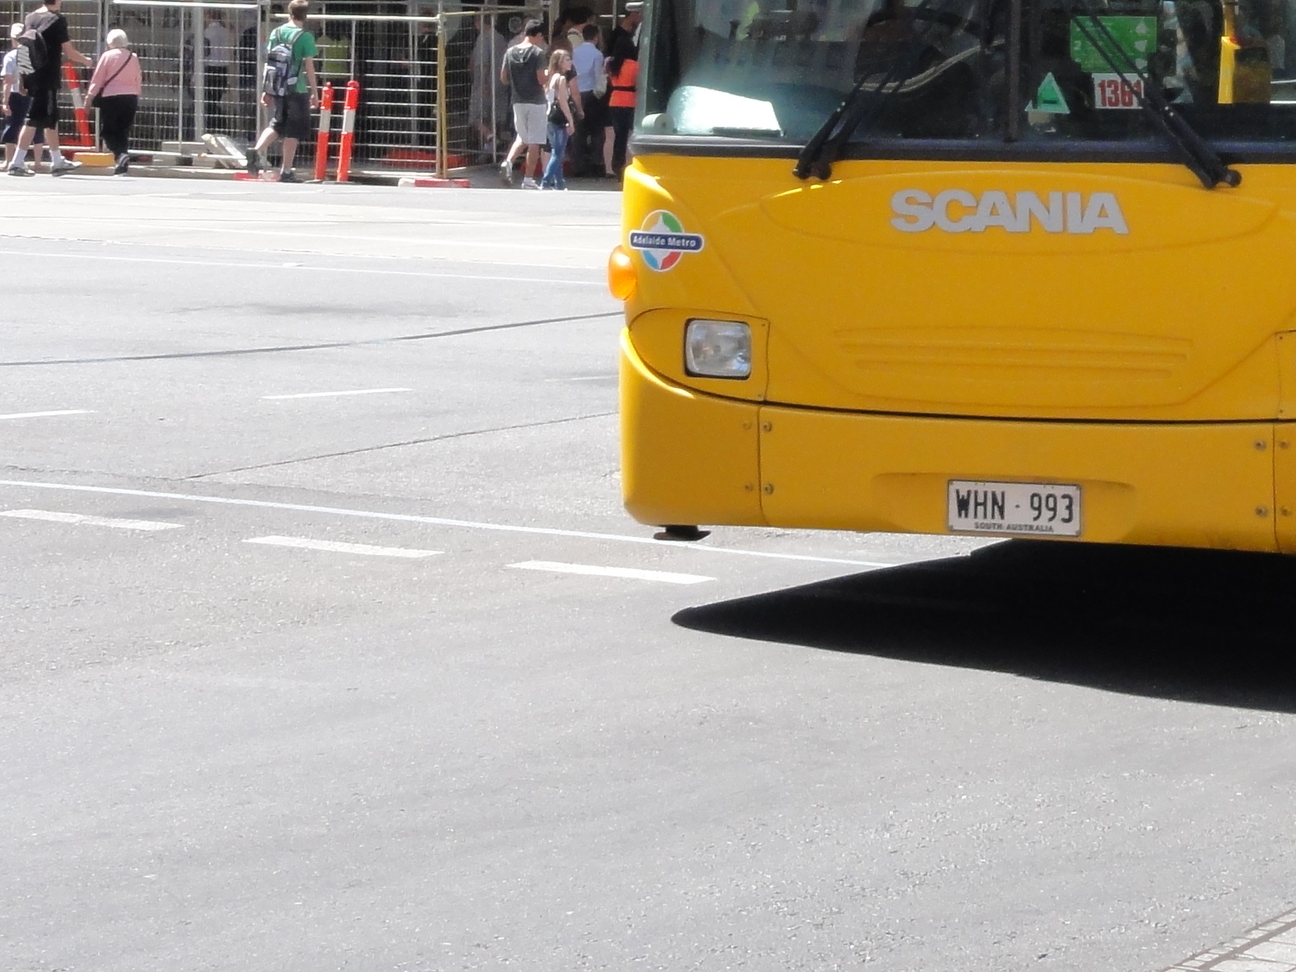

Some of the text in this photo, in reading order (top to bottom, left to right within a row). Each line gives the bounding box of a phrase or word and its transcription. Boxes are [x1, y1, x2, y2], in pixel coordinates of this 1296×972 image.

[890, 189, 1130, 234] SCANIA
[632, 235, 697, 247] Adelaide Metro
[956, 488, 1074, 524] WHN 993
[974, 522, 1054, 533] SOUTH AUSTRALIA
